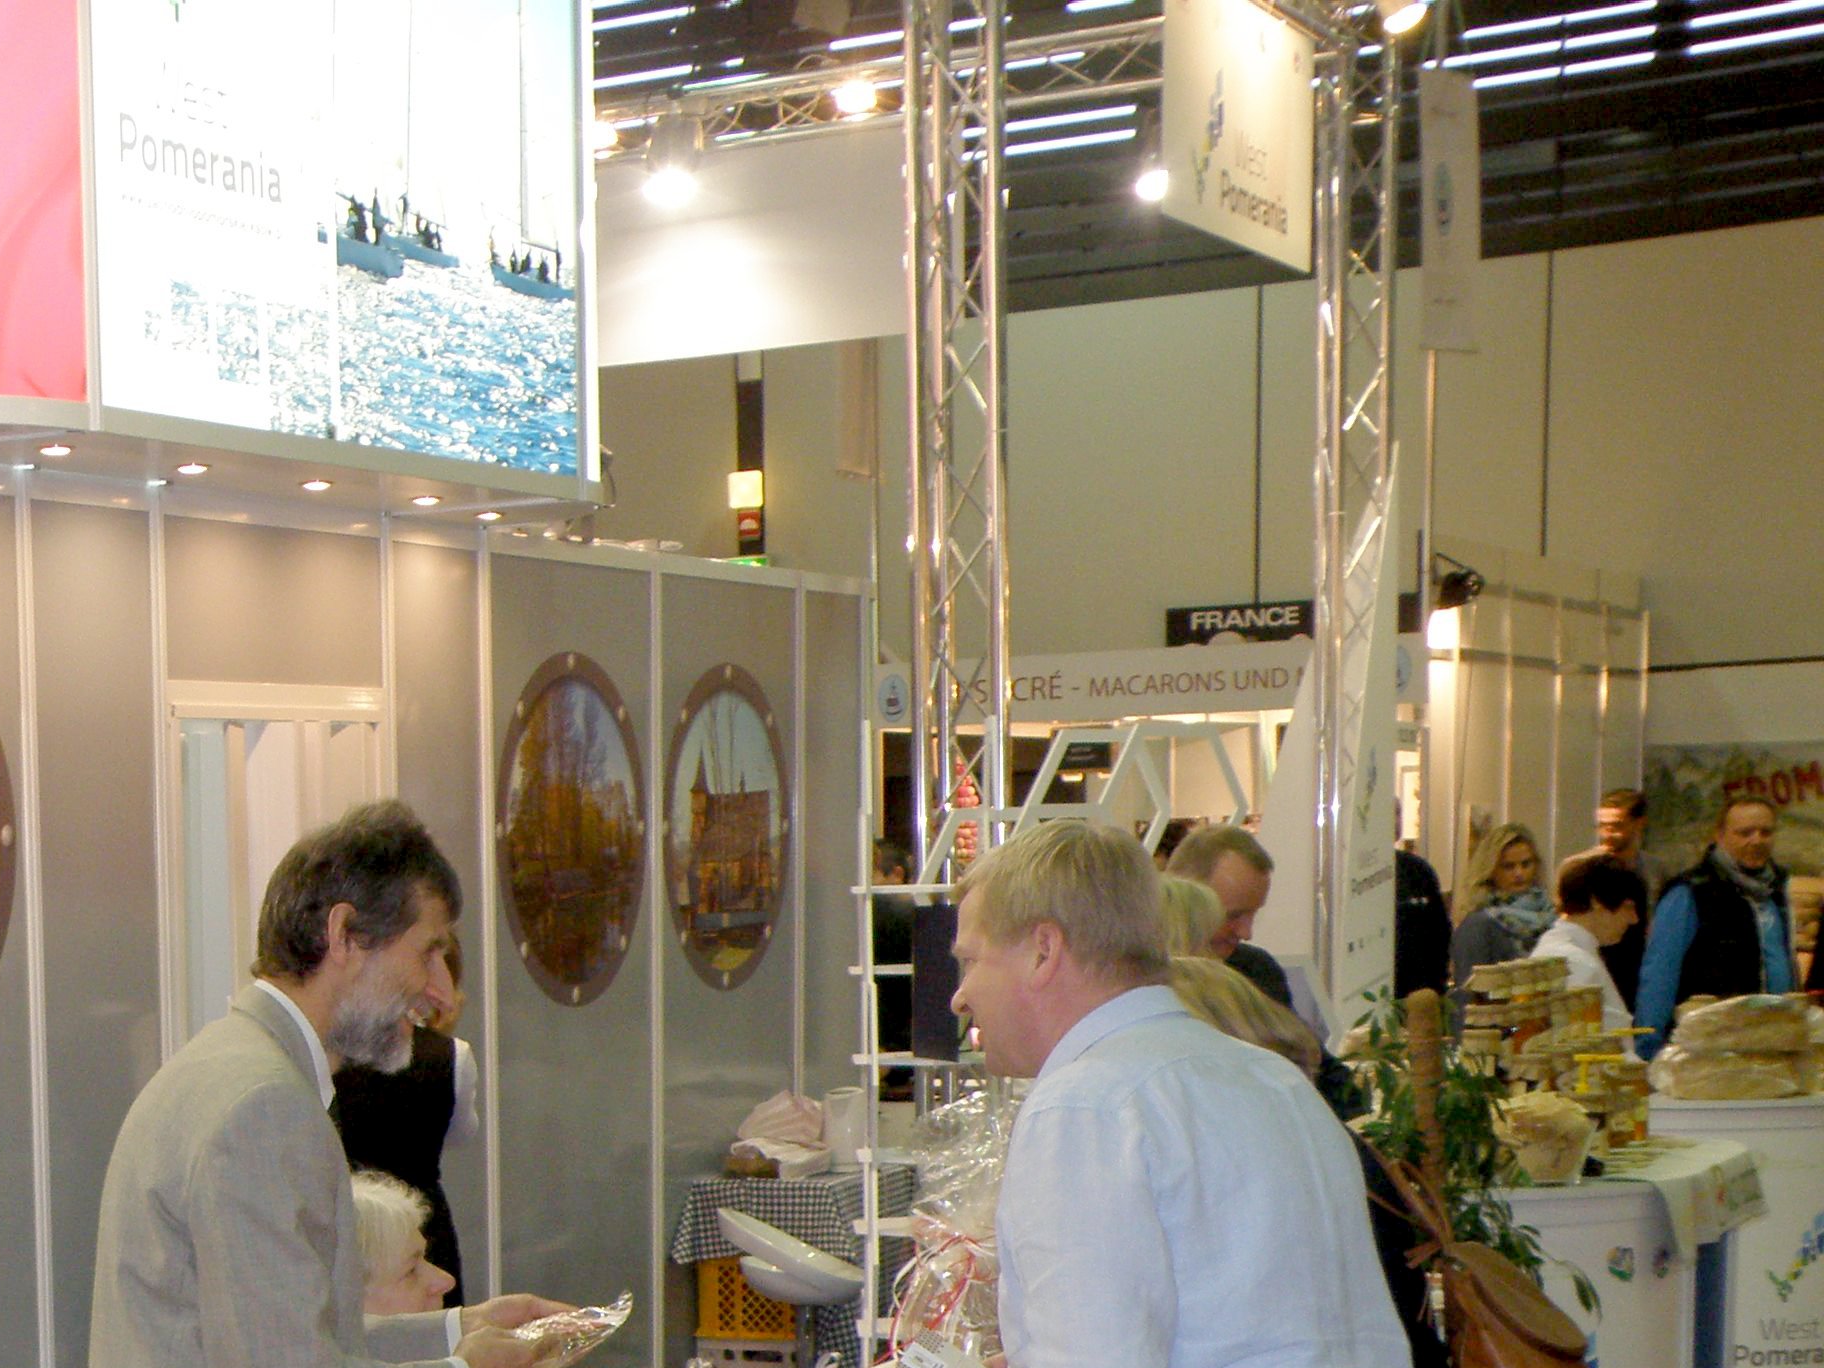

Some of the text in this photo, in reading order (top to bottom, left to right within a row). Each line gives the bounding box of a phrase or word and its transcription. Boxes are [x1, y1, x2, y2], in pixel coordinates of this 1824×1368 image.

[119, 111, 282, 203] Pomerania
[1219, 167, 1288, 235] Pomerania
[1189, 605, 1301, 631] FRANCE
[973, 668, 1064, 705] SCRÉ
[1088, 670, 1228, 699] MACARONS
[1232, 667, 1289, 690] UND
[1758, 1316, 1820, 1341] West
